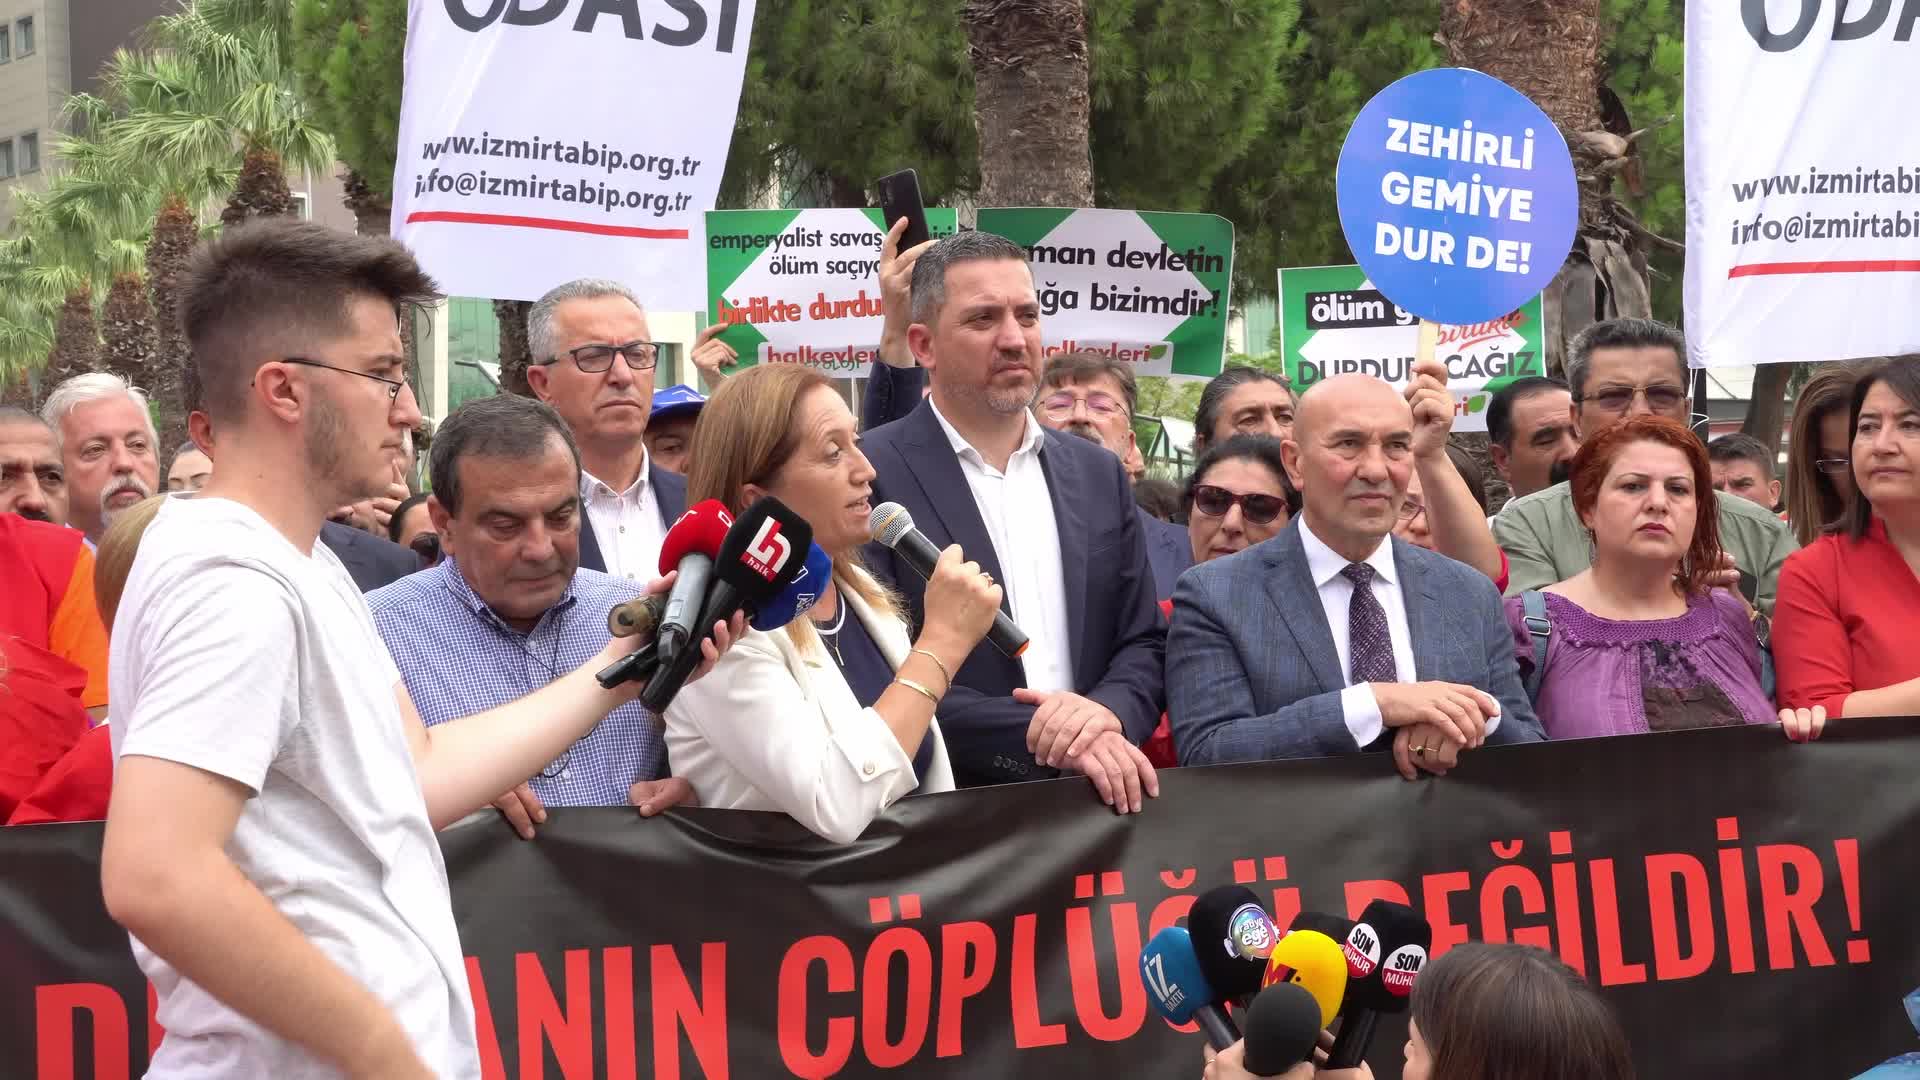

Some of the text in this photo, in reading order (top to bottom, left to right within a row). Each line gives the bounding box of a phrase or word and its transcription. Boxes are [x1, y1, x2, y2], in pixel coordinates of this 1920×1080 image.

[1386, 118, 1534, 170] ZEHİRLİ
[414, 168, 692, 217] ifo@izmirtabip.org.tr
[1381, 172, 1533, 223] GEMİYE
[711, 227, 883, 254] emperyalist savaş
[1375, 222, 1532, 275] DUR DE!
[769, 257, 880, 280] ölüm saçıyo
[1023, 240, 1223, 273] man devletin
[717, 289, 884, 326] birlikte durdu
[1036, 281, 1221, 318] ğa bizimdir!
[1311, 293, 1384, 323] ölüm
[746, 557, 770, 576] halk
[1352, 928, 1375, 956] SON
[1395, 953, 1422, 972] SON
[1384, 972, 1417, 986] MÜH
